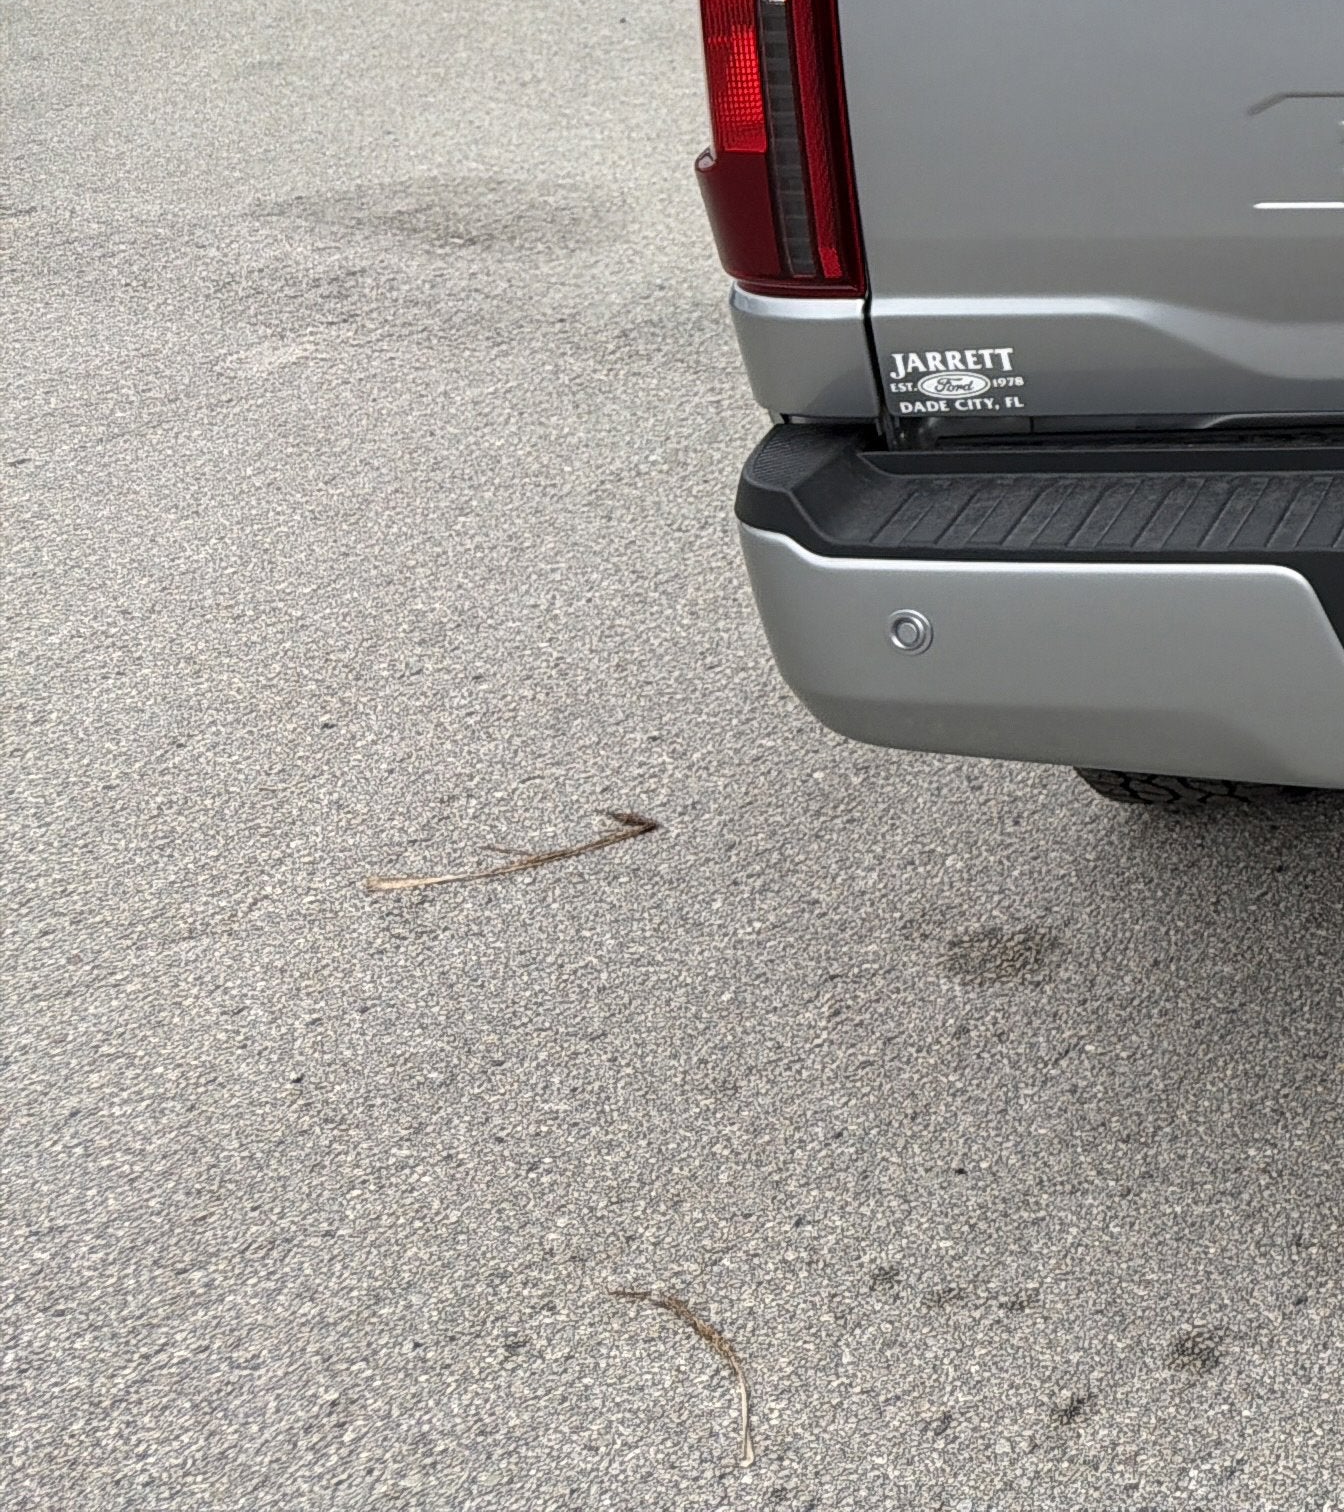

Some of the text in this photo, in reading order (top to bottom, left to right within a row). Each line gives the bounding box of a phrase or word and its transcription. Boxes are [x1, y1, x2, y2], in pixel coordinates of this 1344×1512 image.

[890, 347, 1013, 379] JARRETT
[889, 376, 1025, 393] EST. Ford 1978
[900, 396, 1024, 414] DADE CITY, FL
